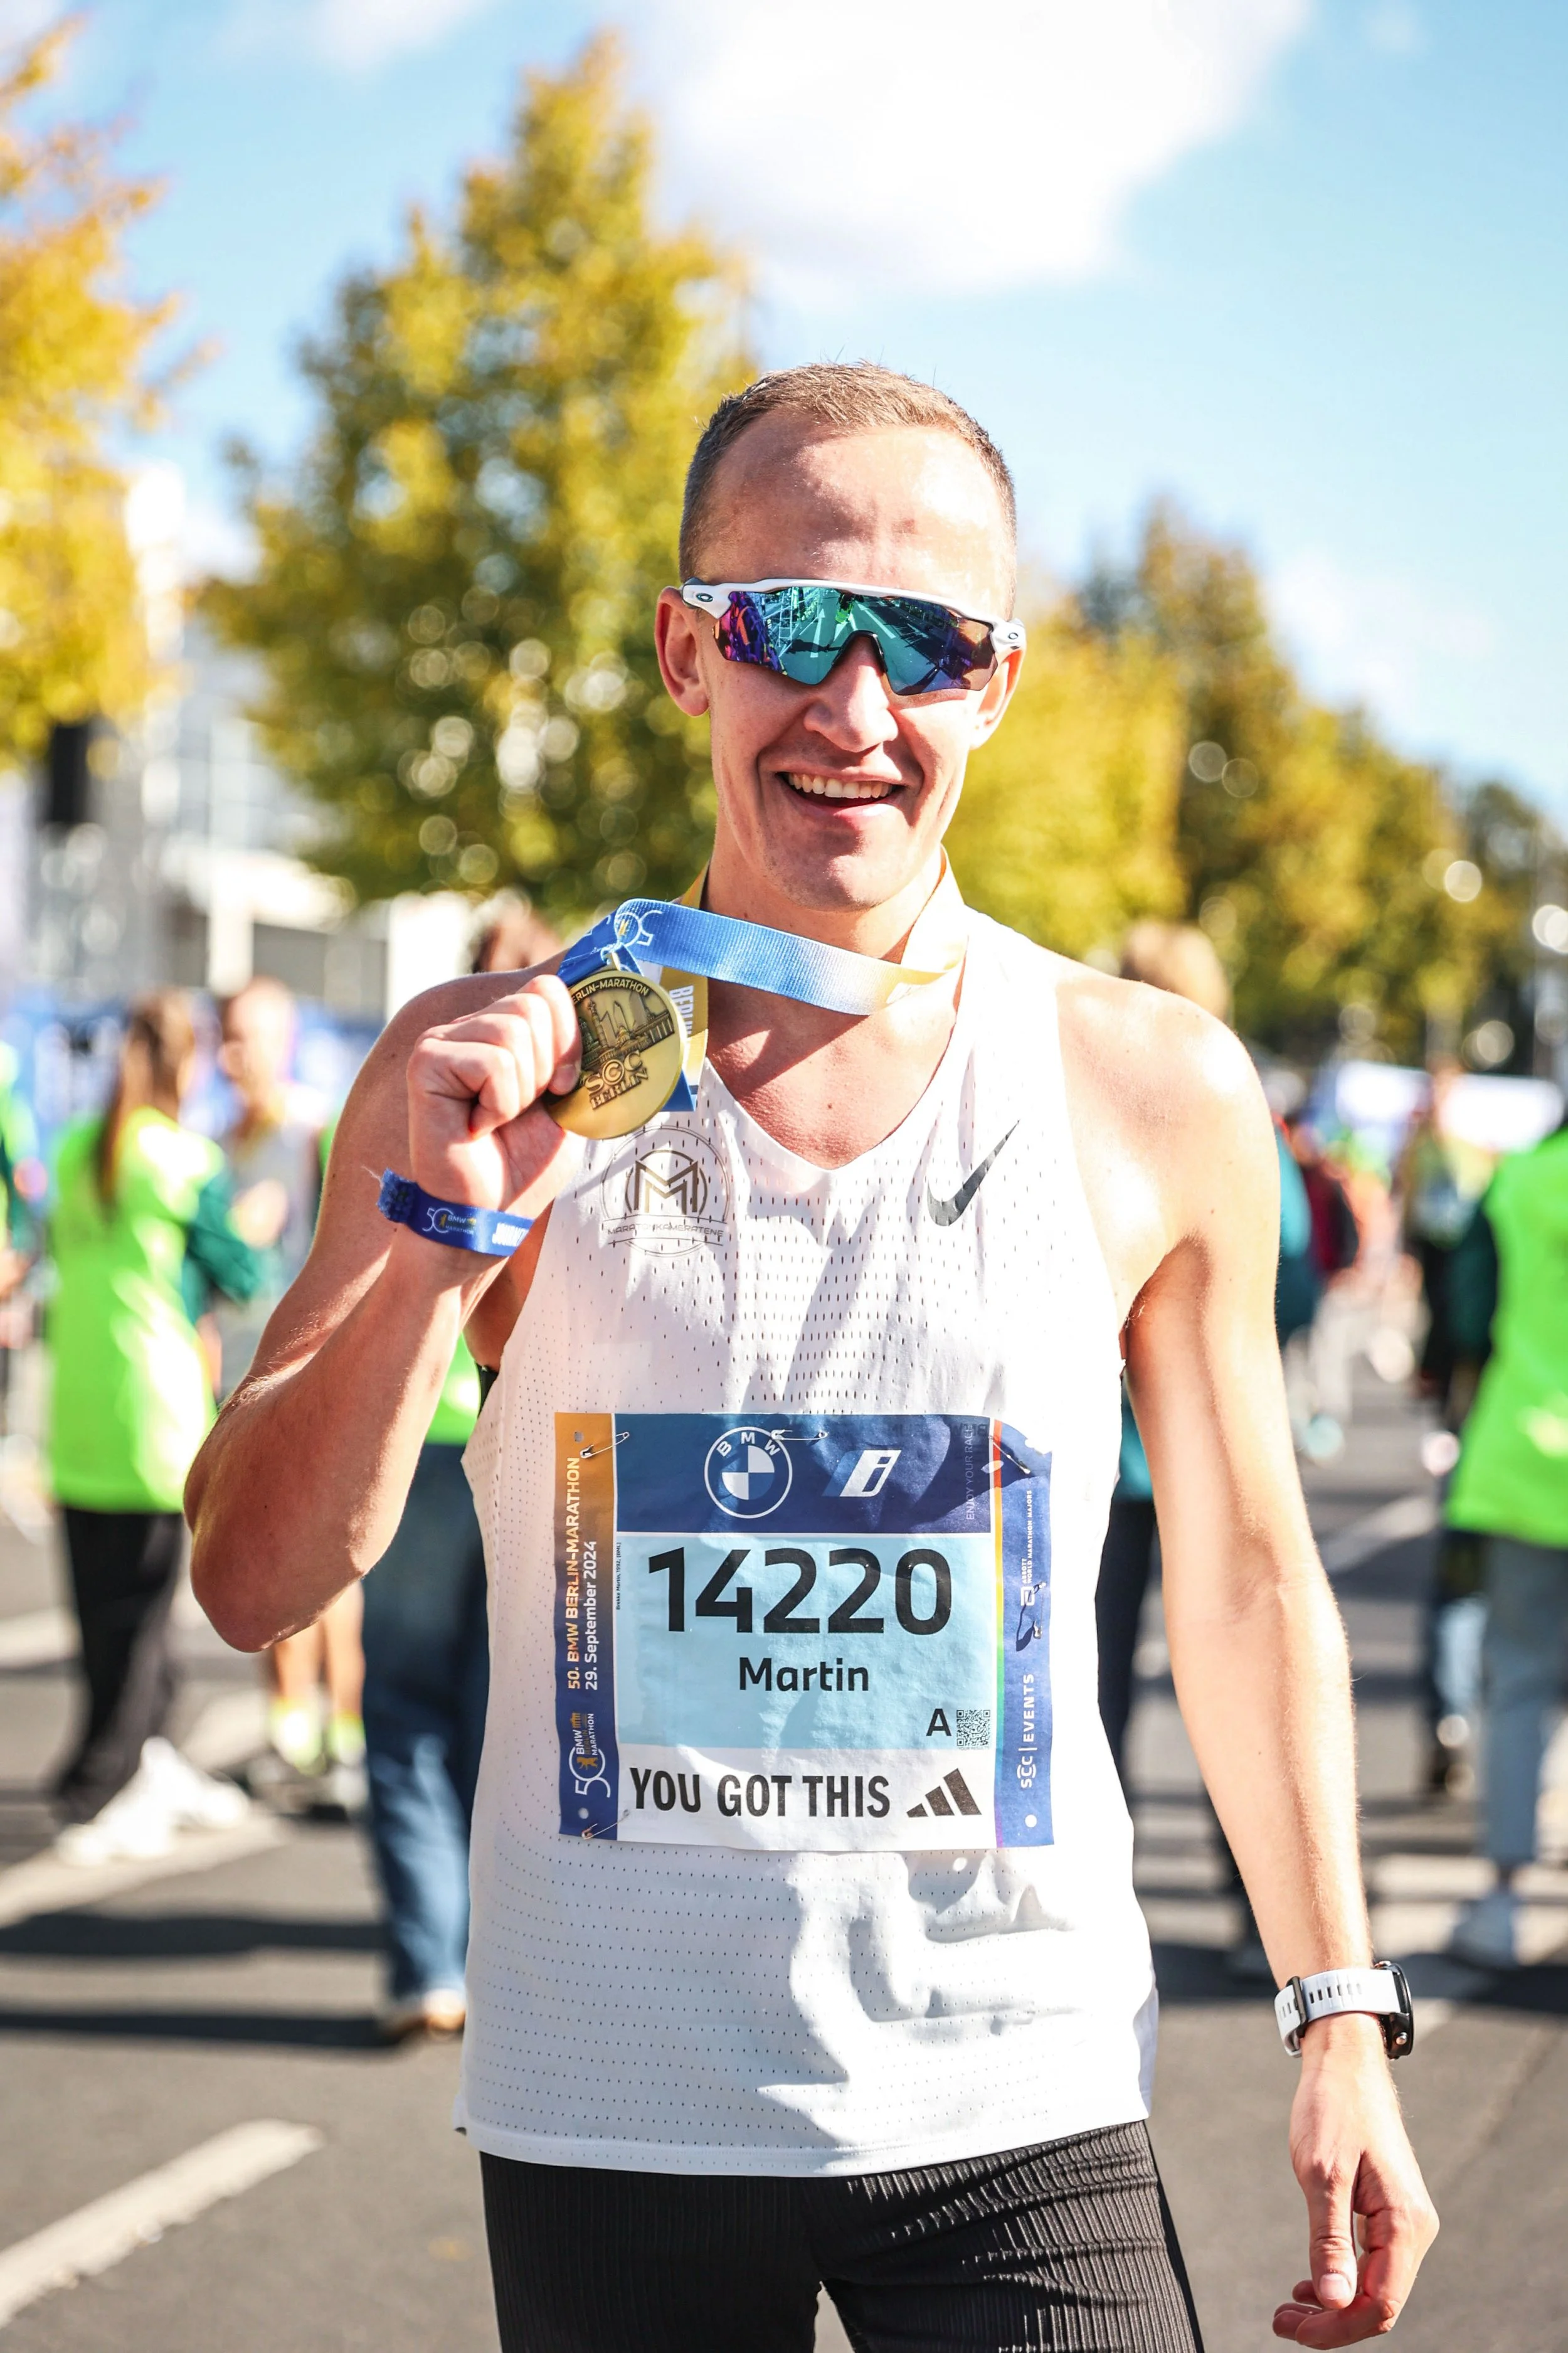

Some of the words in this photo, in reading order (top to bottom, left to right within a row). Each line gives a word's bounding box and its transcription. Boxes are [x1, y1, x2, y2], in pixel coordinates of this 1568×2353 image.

[572, 978, 649, 1003] ERLIN-MARATHON
[585, 1050, 643, 1095] SCC
[422, 1208, 453, 1233] 50
[447, 1214, 467, 1224] BMW
[716, 1431, 781, 1457] BMW
[963, 1425, 974, 1453] RACE
[965, 1455, 974, 1485] YOUR
[965, 1487, 975, 1520] ENJOY
[565, 1457, 580, 1619] BERLIN-MARATHON
[583, 1541, 597, 1580] 2024
[648, 1547, 953, 1636] 14220
[583, 1584, 600, 1663] September
[565, 1622, 580, 1662] BMW
[566, 1666, 581, 1689] 50.
[584, 1667, 598, 1691] 29.
[739, 1657, 869, 1692] Martin
[926, 1708, 952, 1737] A
[1023, 1674, 1035, 1743] EVENTS
[572, 1729, 585, 1755] BMW
[587, 1713, 598, 1756] MARATHON
[569, 1746, 611, 1798] 50
[630, 1767, 701, 1814] YOU
[717, 1775, 792, 1817] GOT
[802, 1775, 891, 1819] THIS
